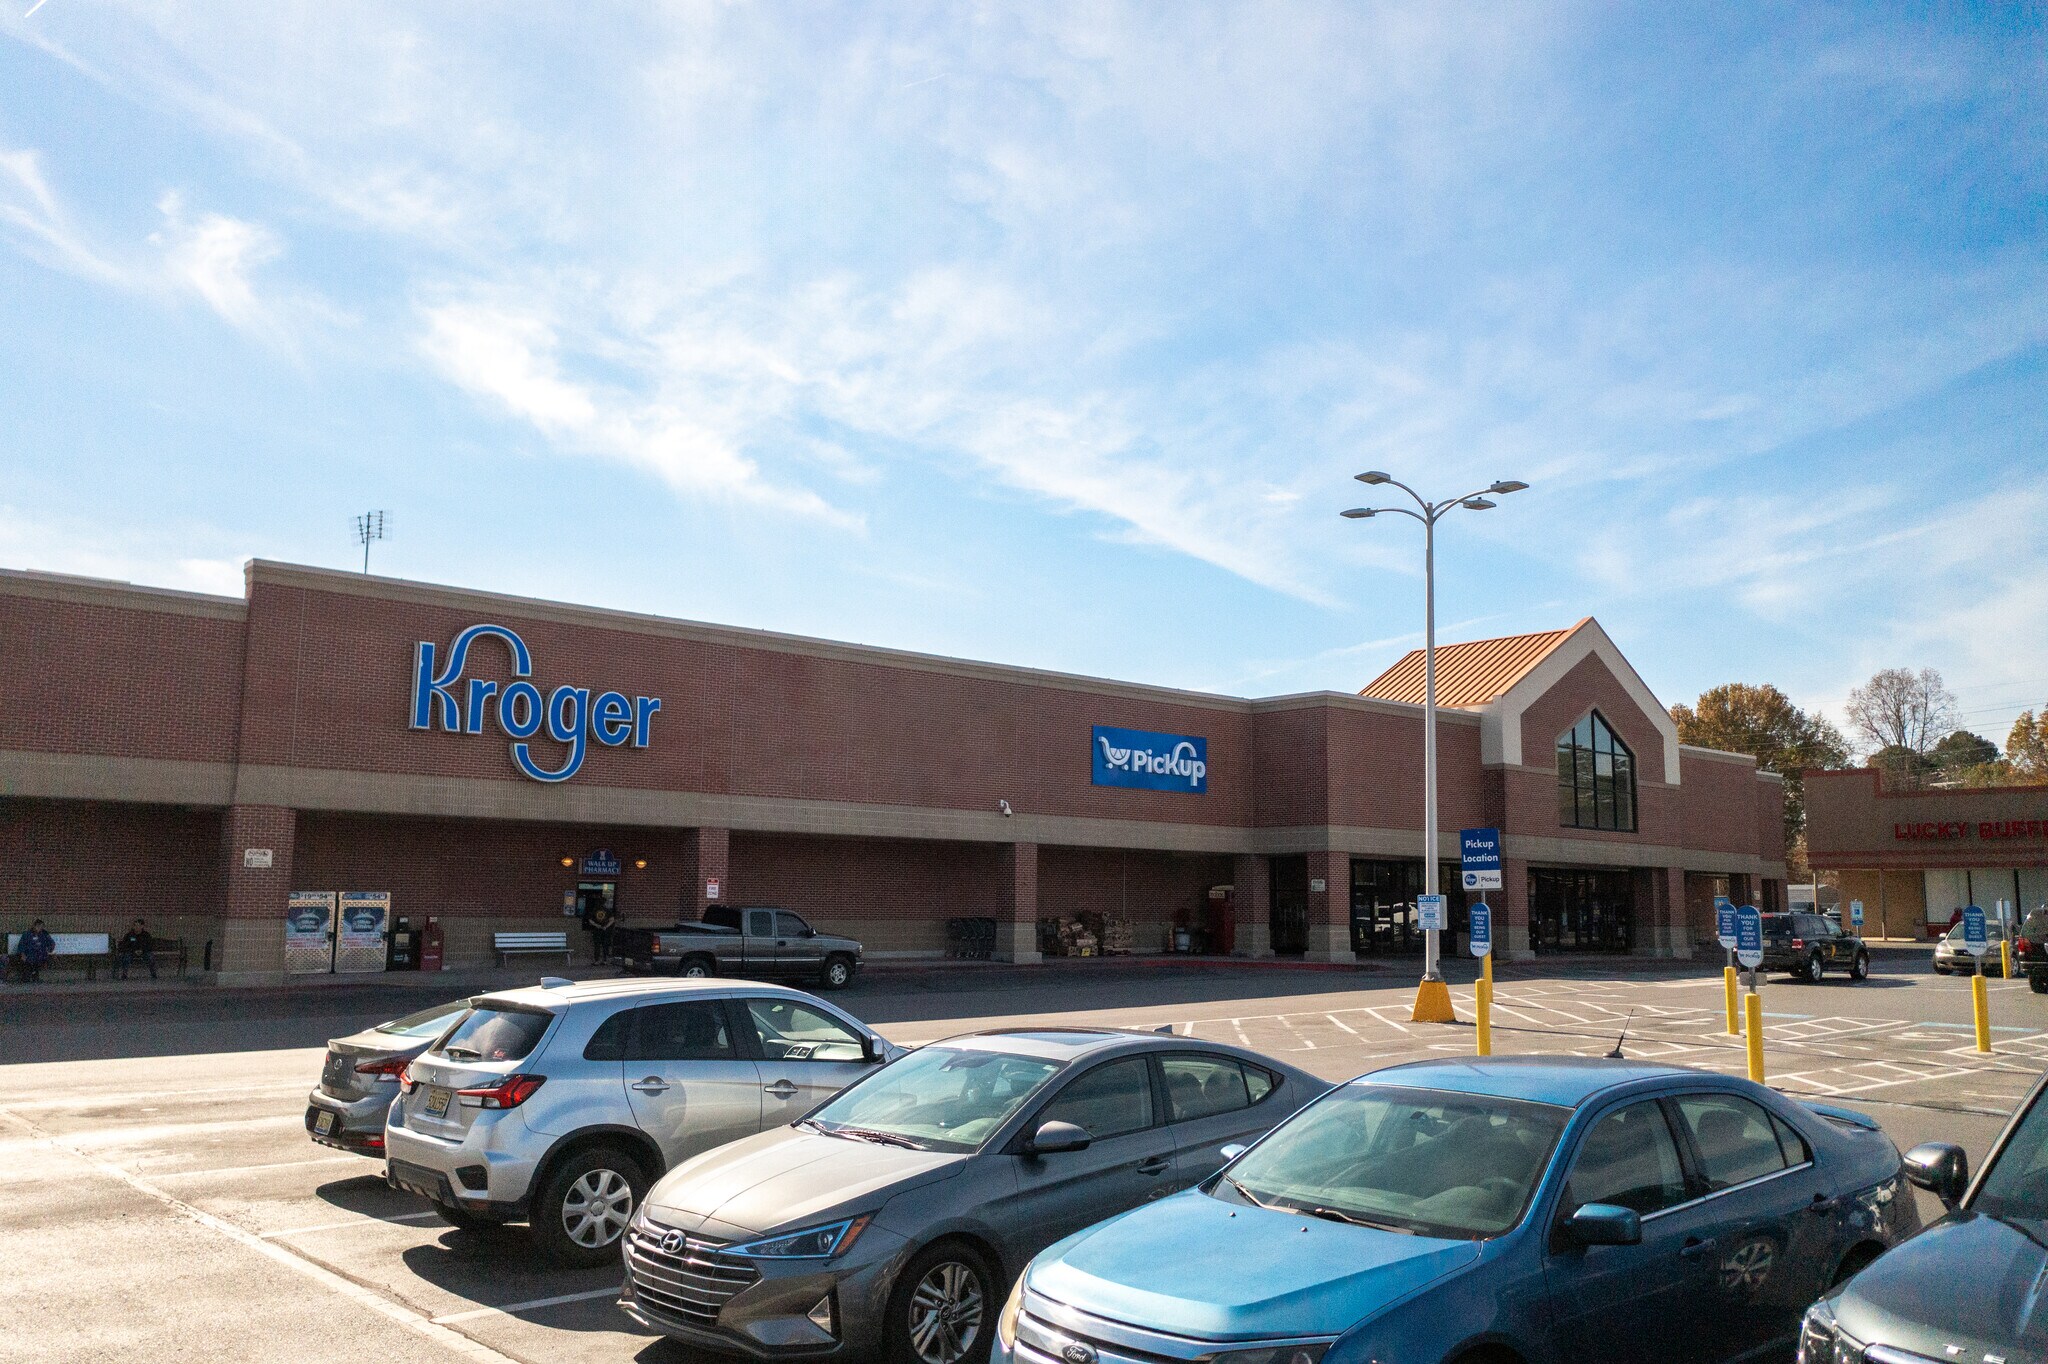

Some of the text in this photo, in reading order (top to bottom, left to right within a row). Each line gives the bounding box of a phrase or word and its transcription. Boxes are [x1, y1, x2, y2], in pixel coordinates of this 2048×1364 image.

[409, 624, 661, 782] Kroger
[1132, 741, 1206, 787] Pickup
[1895, 821, 1967, 840] LUCKY
[1465, 839, 1494, 850] Pickup
[1463, 853, 1499, 863] Location
[1066, 1346, 1087, 1362] Ford
